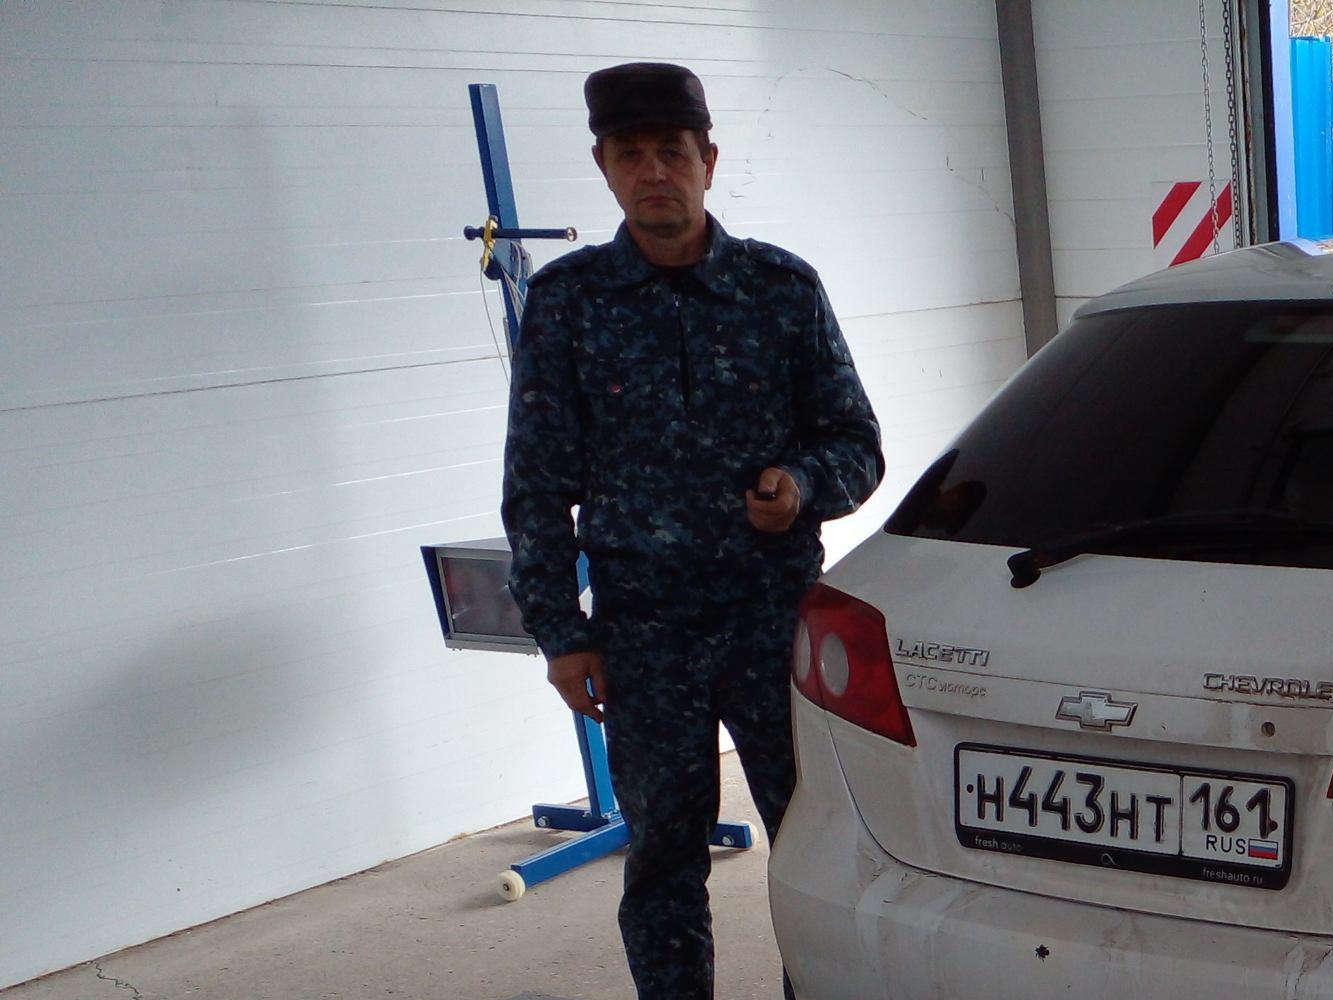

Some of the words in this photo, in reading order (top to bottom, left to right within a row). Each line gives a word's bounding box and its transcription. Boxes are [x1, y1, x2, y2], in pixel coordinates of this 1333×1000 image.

[895, 638, 990, 667] LACETTI
[1189, 782, 1269, 839] 161
[975, 836, 999, 849] fresh
[1205, 835, 1246, 854] RUS
[1203, 866, 1264, 885] freshautoru
